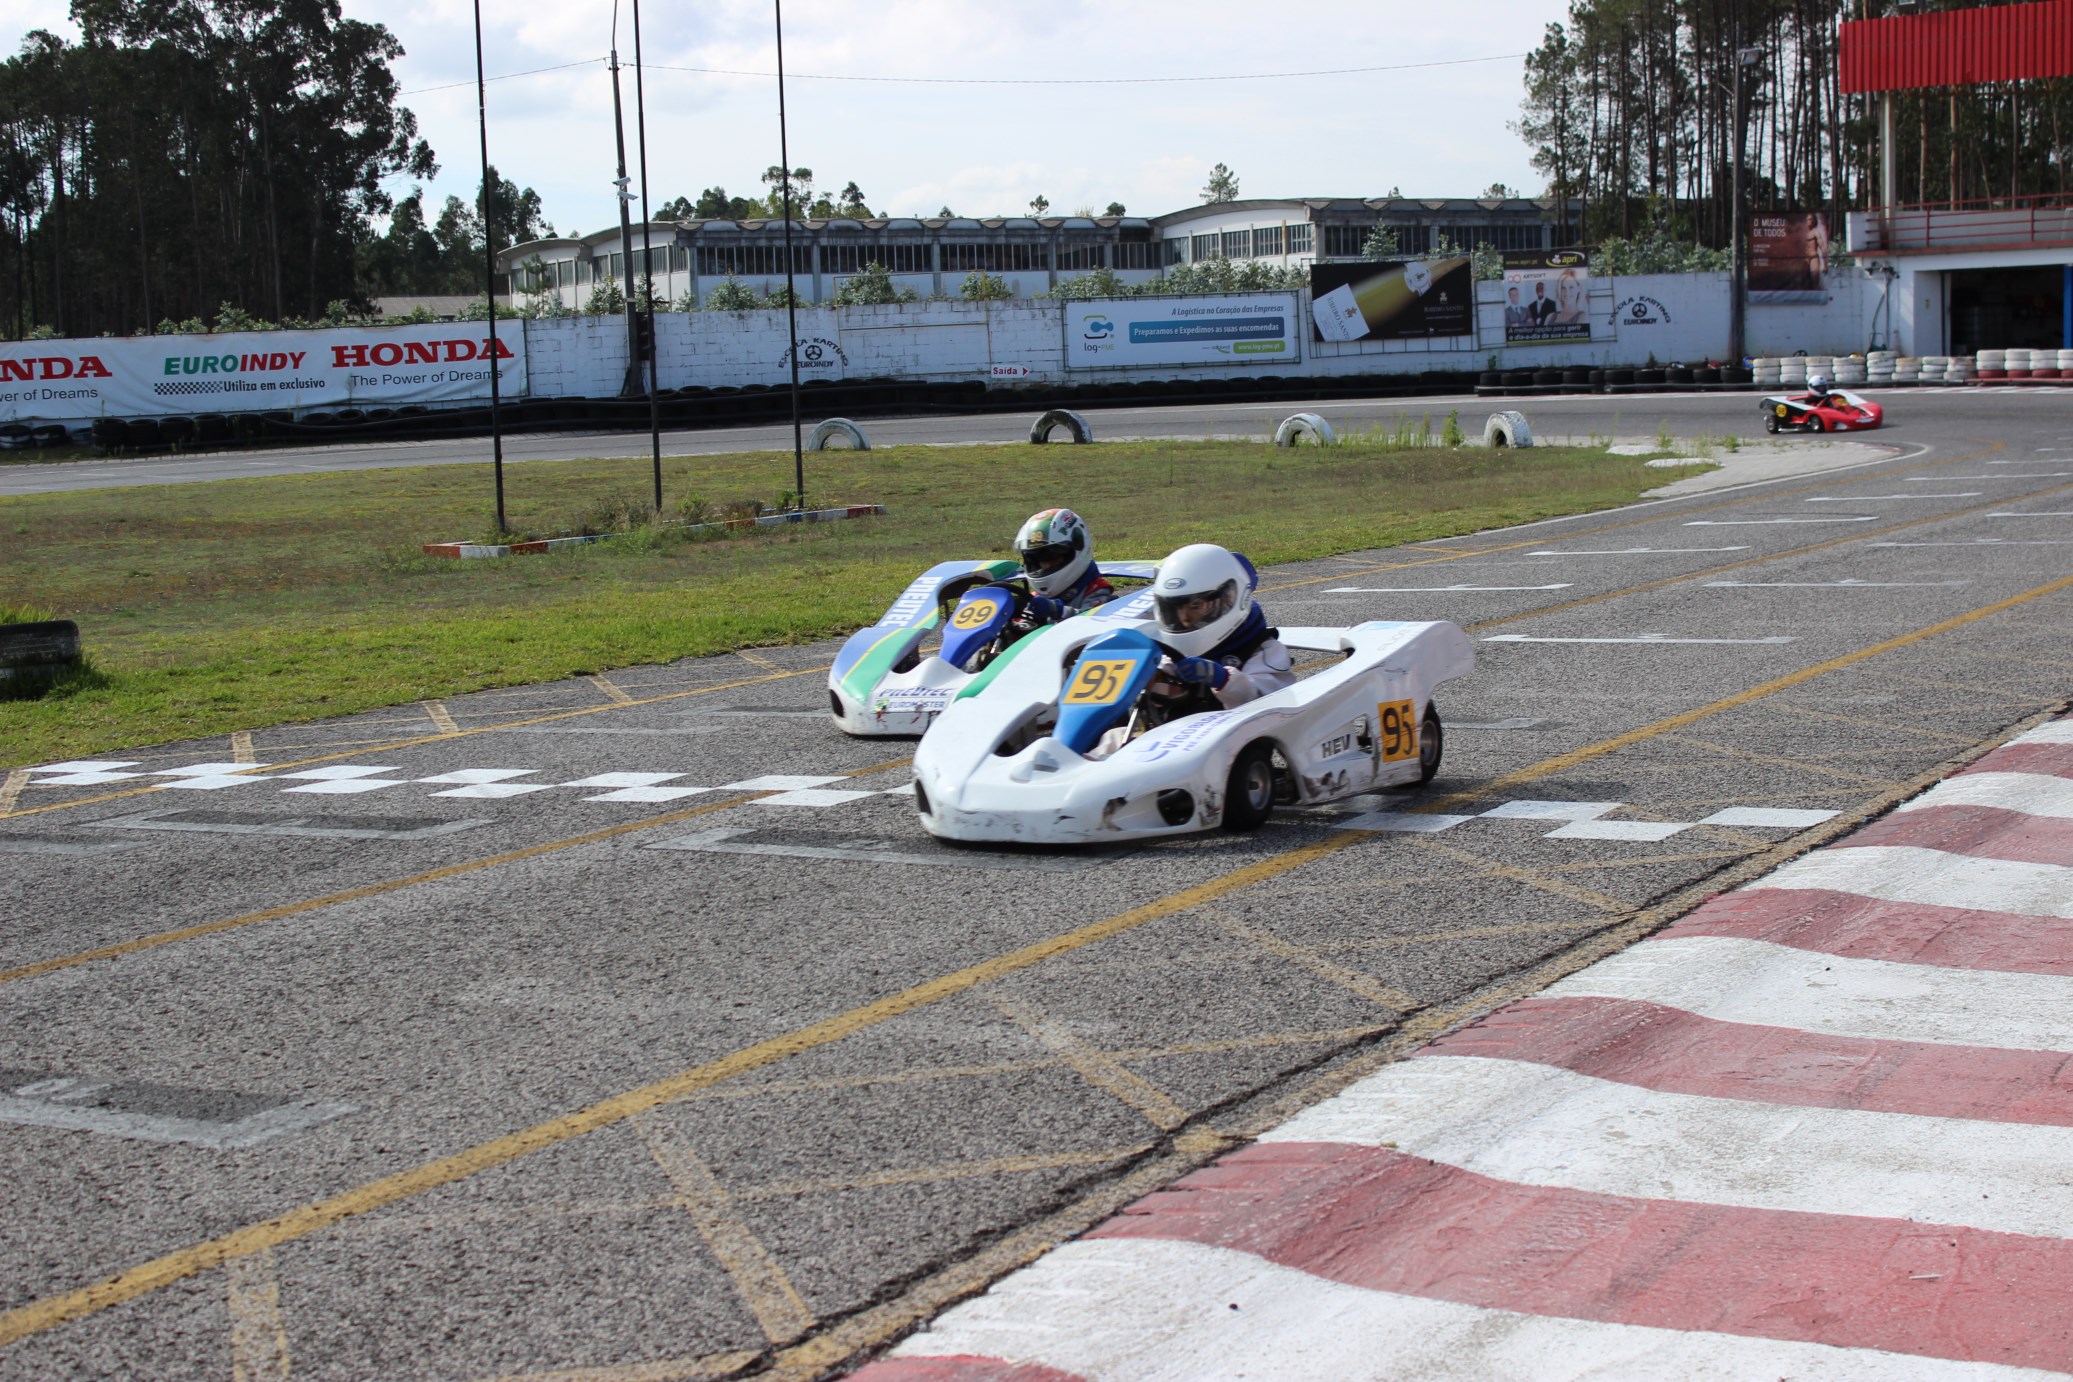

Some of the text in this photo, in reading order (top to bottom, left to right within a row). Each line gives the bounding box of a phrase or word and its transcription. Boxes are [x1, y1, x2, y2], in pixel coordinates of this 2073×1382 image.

[1761, 218, 1786, 227] MUSEU
[1753, 228, 1787, 238] DE TODOS
[1562, 255, 1577, 265] apri
[1172, 308, 1177, 316] A
[1178, 307, 1205, 317] Logística
[1215, 306, 1241, 316] Coração
[1242, 305, 1253, 314] das
[1254, 305, 1284, 315] Empresas
[1639, 296, 1672, 324] KARTING
[1134, 327, 1174, 337] Preparamos
[1179, 325, 1215, 336] Expedimos
[1215, 326, 1223, 334] as
[1223, 325, 1238, 333] suas
[1239, 323, 1280, 333] encomendas
[331, 338, 515, 368] HONDA
[813, 337, 848, 367] KARTING
[0, 356, 112, 382] NDA
[163, 351, 307, 375] EUROINDY
[223, 377, 326, 392] Utiliza em exclusivo
[351, 369, 504, 387] The Power of Dreams
[23, 389, 38, 401] of
[41, 387, 99, 400] Dreams
[956, 605, 992, 624] 99
[1072, 663, 1127, 700] 95
[1383, 703, 1414, 756] 95
[1321, 733, 1351, 758] HEV
